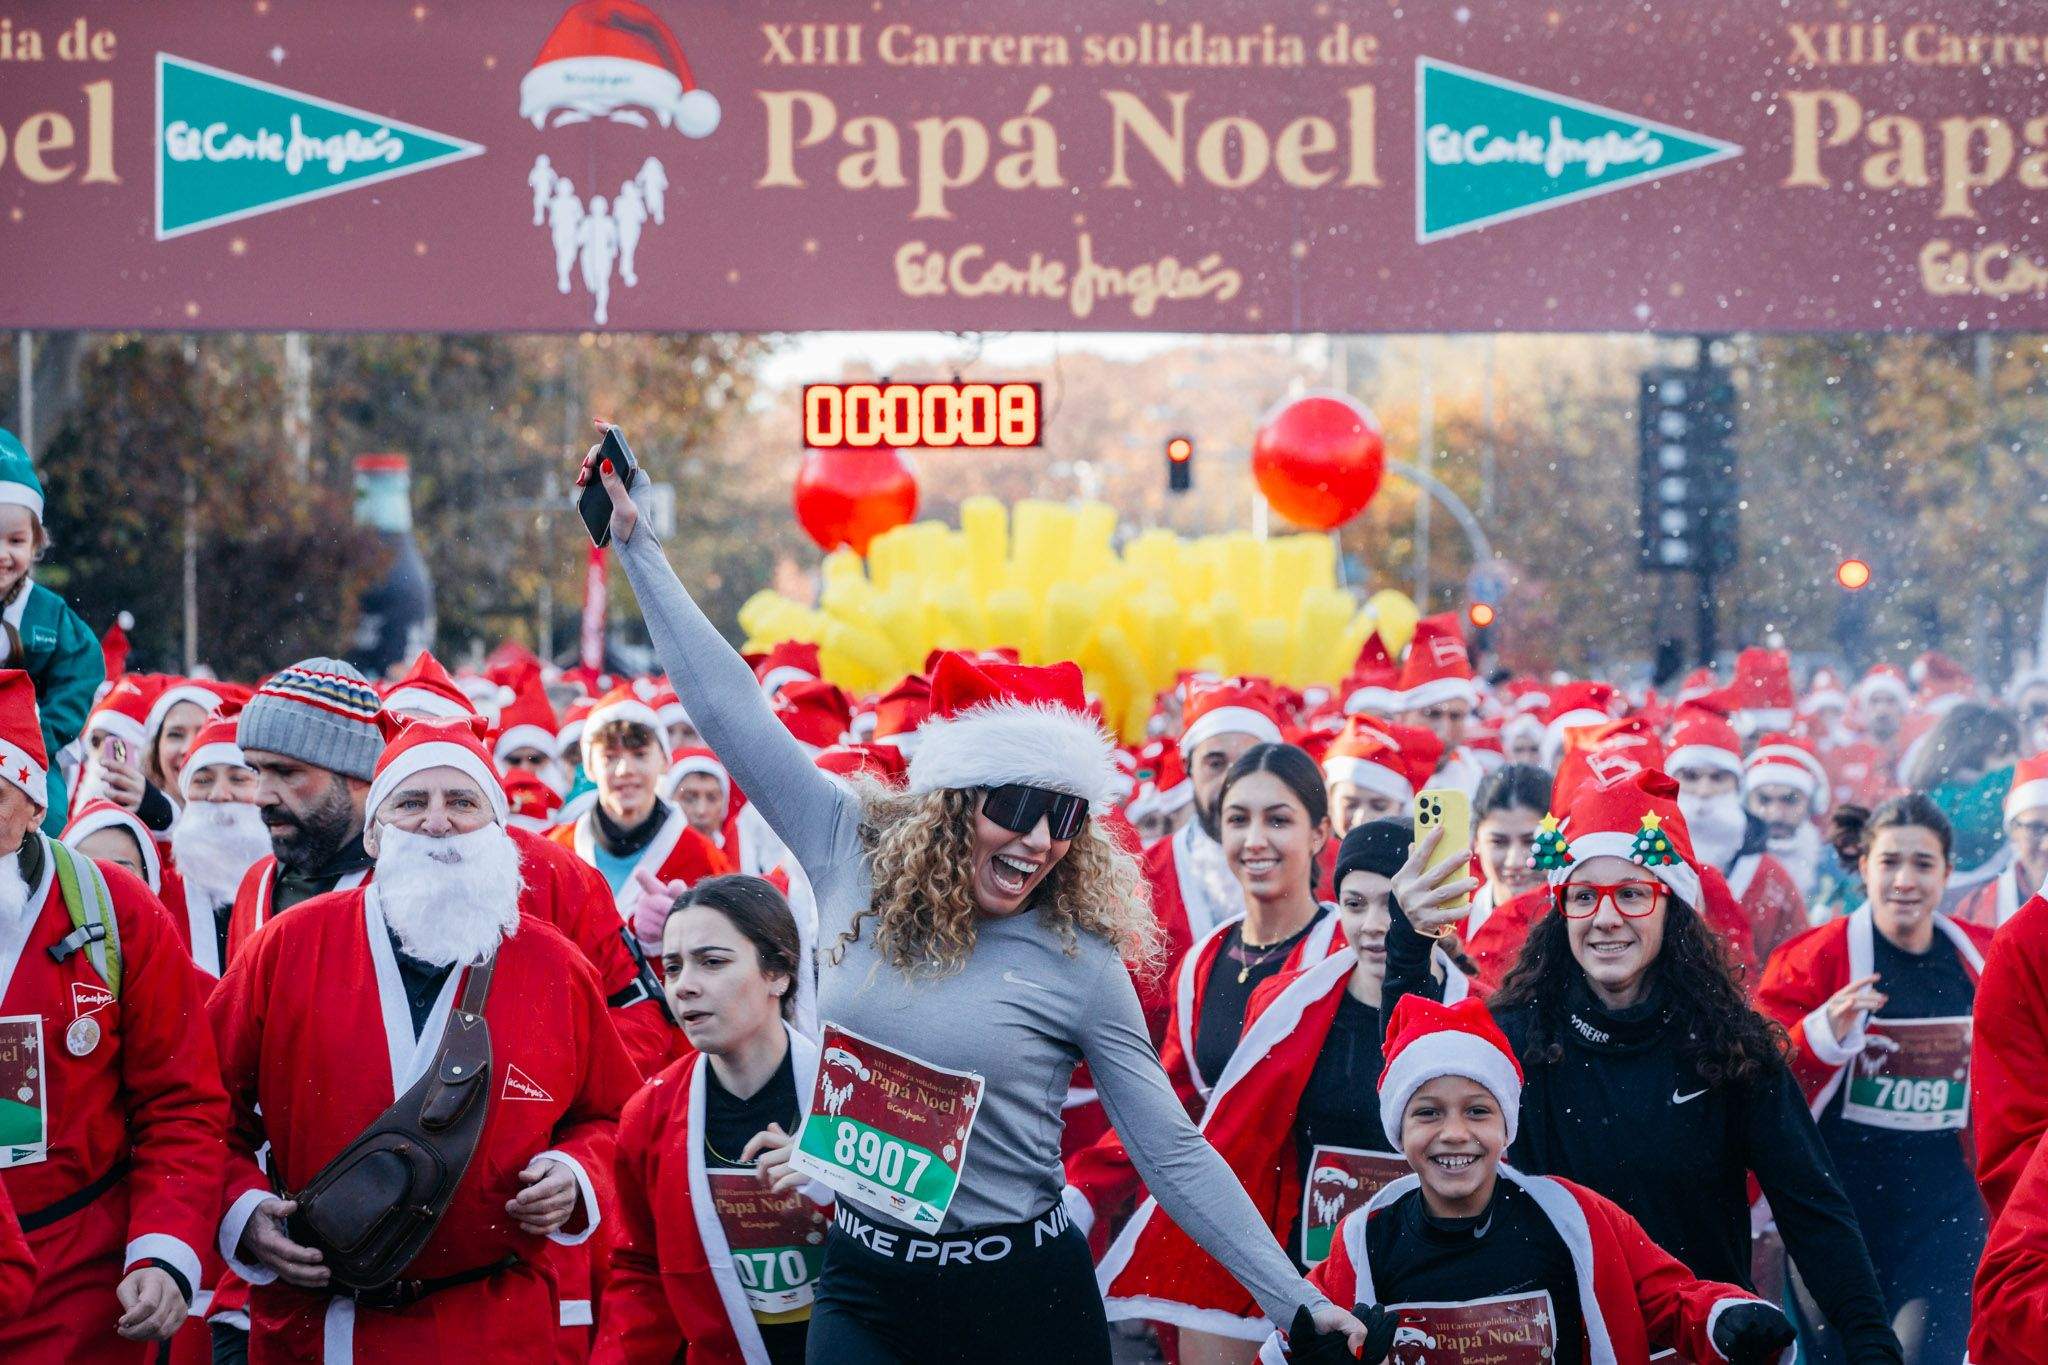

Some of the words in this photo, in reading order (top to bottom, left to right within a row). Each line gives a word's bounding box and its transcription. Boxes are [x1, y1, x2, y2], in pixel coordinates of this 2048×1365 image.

[57, 17, 117, 61] de
[762, 23, 862, 66] XIII
[877, 26, 1069, 66] Carrera
[1083, 22, 1304, 66] solidaria
[1318, 22, 1378, 66] de
[1786, 23, 1889, 66] XIII
[165, 120, 201, 161] El
[202, 121, 285, 162] Corte
[755, 84, 1066, 220] Papá
[1101, 84, 1384, 189] Noel
[1426, 123, 1463, 165] El
[1463, 124, 1544, 166] Corte
[895, 240, 948, 297] El
[949, 244, 1068, 297] Corte
[1069, 232, 1242, 318] Inglés
[1920, 240, 1972, 296] El
[806, 384, 1036, 446] 00:00:08
[870, 1068, 911, 1099] Papá
[915, 1086, 956, 1115] Noel
[1874, 1076, 1949, 1112] 7069
[834, 1121, 932, 1194] 8907
[761, 1193, 802, 1213] Noel
[834, 1201, 900, 1258] NIKE
[905, 1235, 1012, 1266] PRO
[1436, 1329, 1482, 1355] Papá
[1488, 1323, 1531, 1345] Noel
